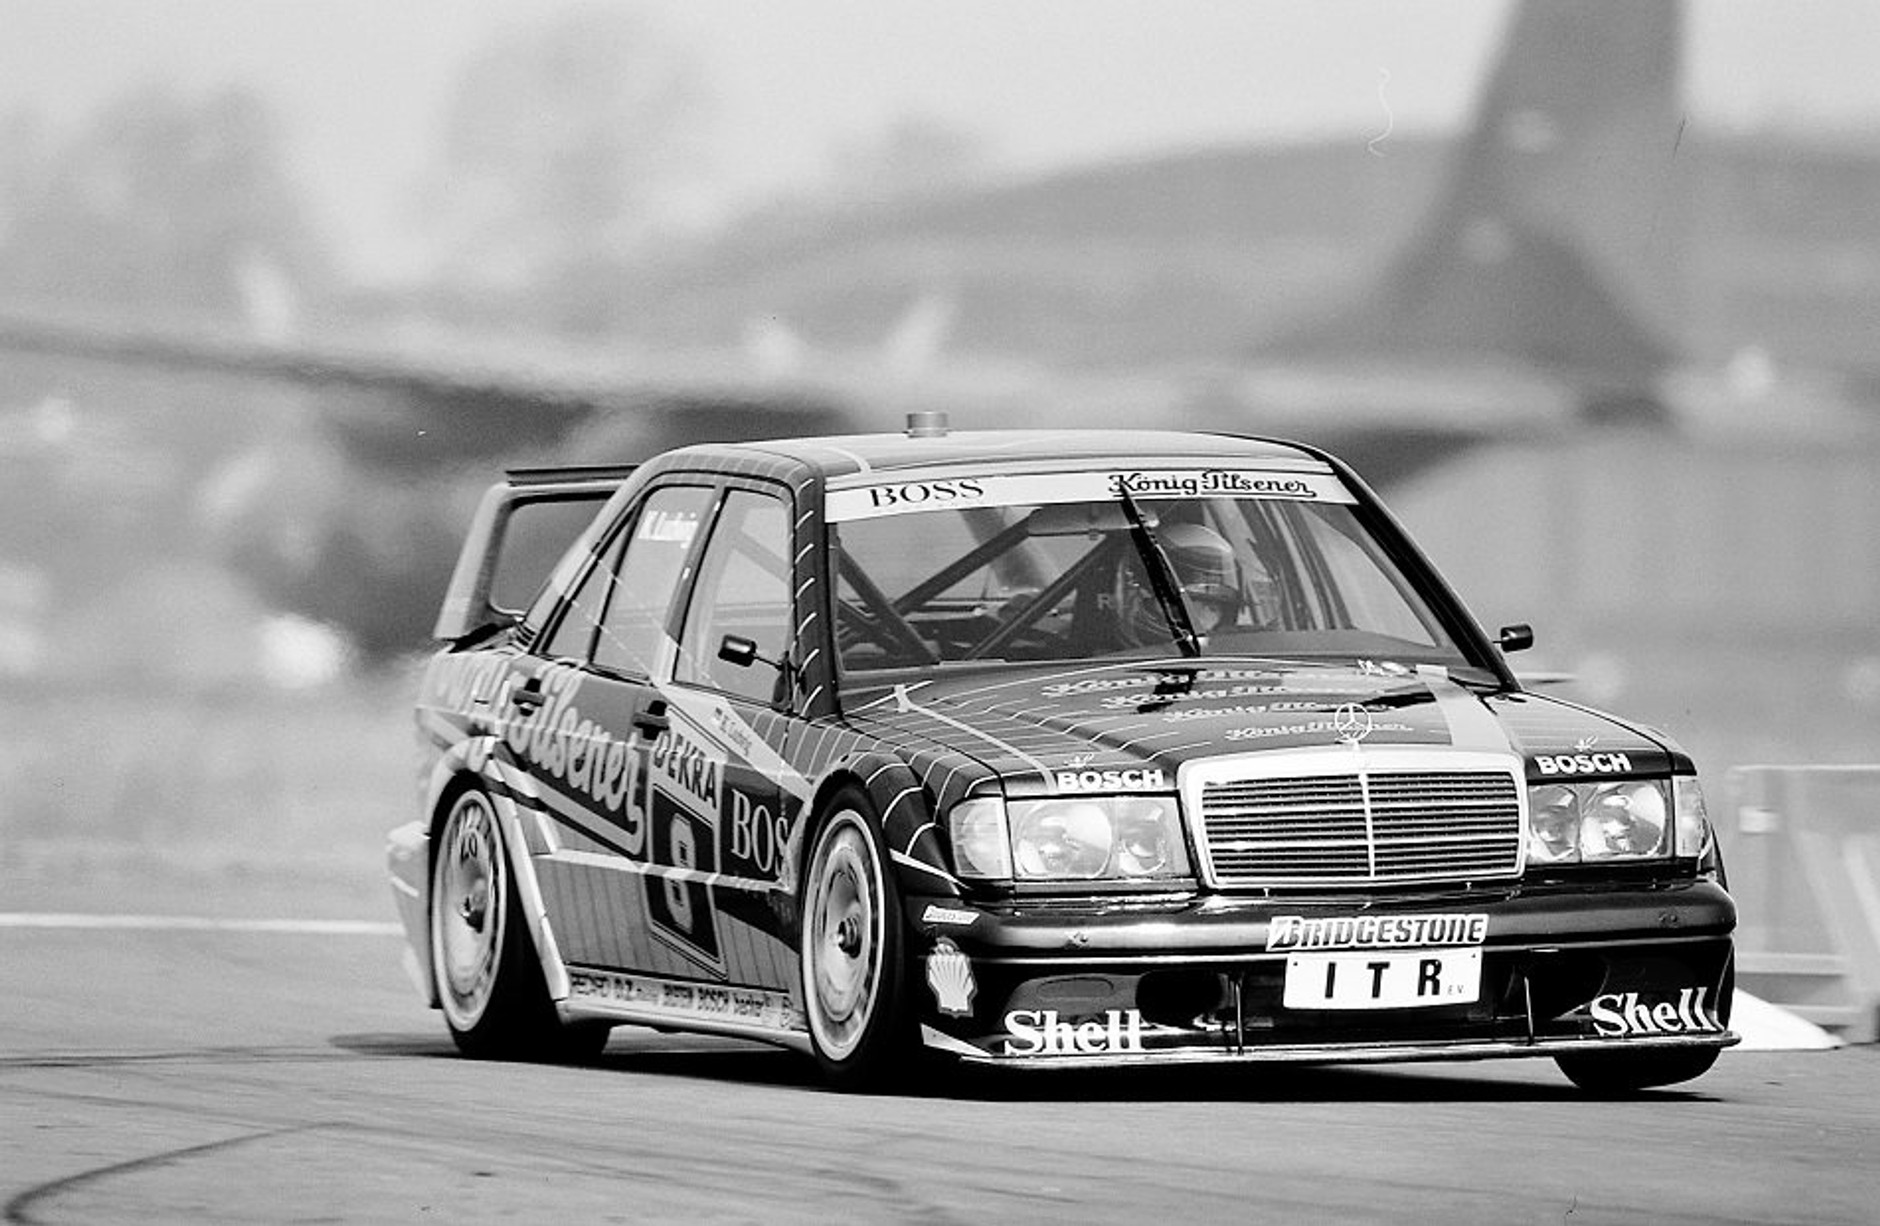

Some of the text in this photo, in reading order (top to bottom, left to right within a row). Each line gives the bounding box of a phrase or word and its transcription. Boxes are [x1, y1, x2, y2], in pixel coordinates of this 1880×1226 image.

[870, 480, 984, 507] BOSS
[1108, 470, 1318, 497] König Pilsener
[654, 730, 718, 810] DEKRA
[1534, 752, 1632, 775] BOSCH
[1057, 768, 1164, 790] BOSCH
[1271, 917, 1485, 948] BRIDGESTONE
[1591, 986, 1719, 1037] Shell
[1004, 1009, 1146, 1056] Shell
